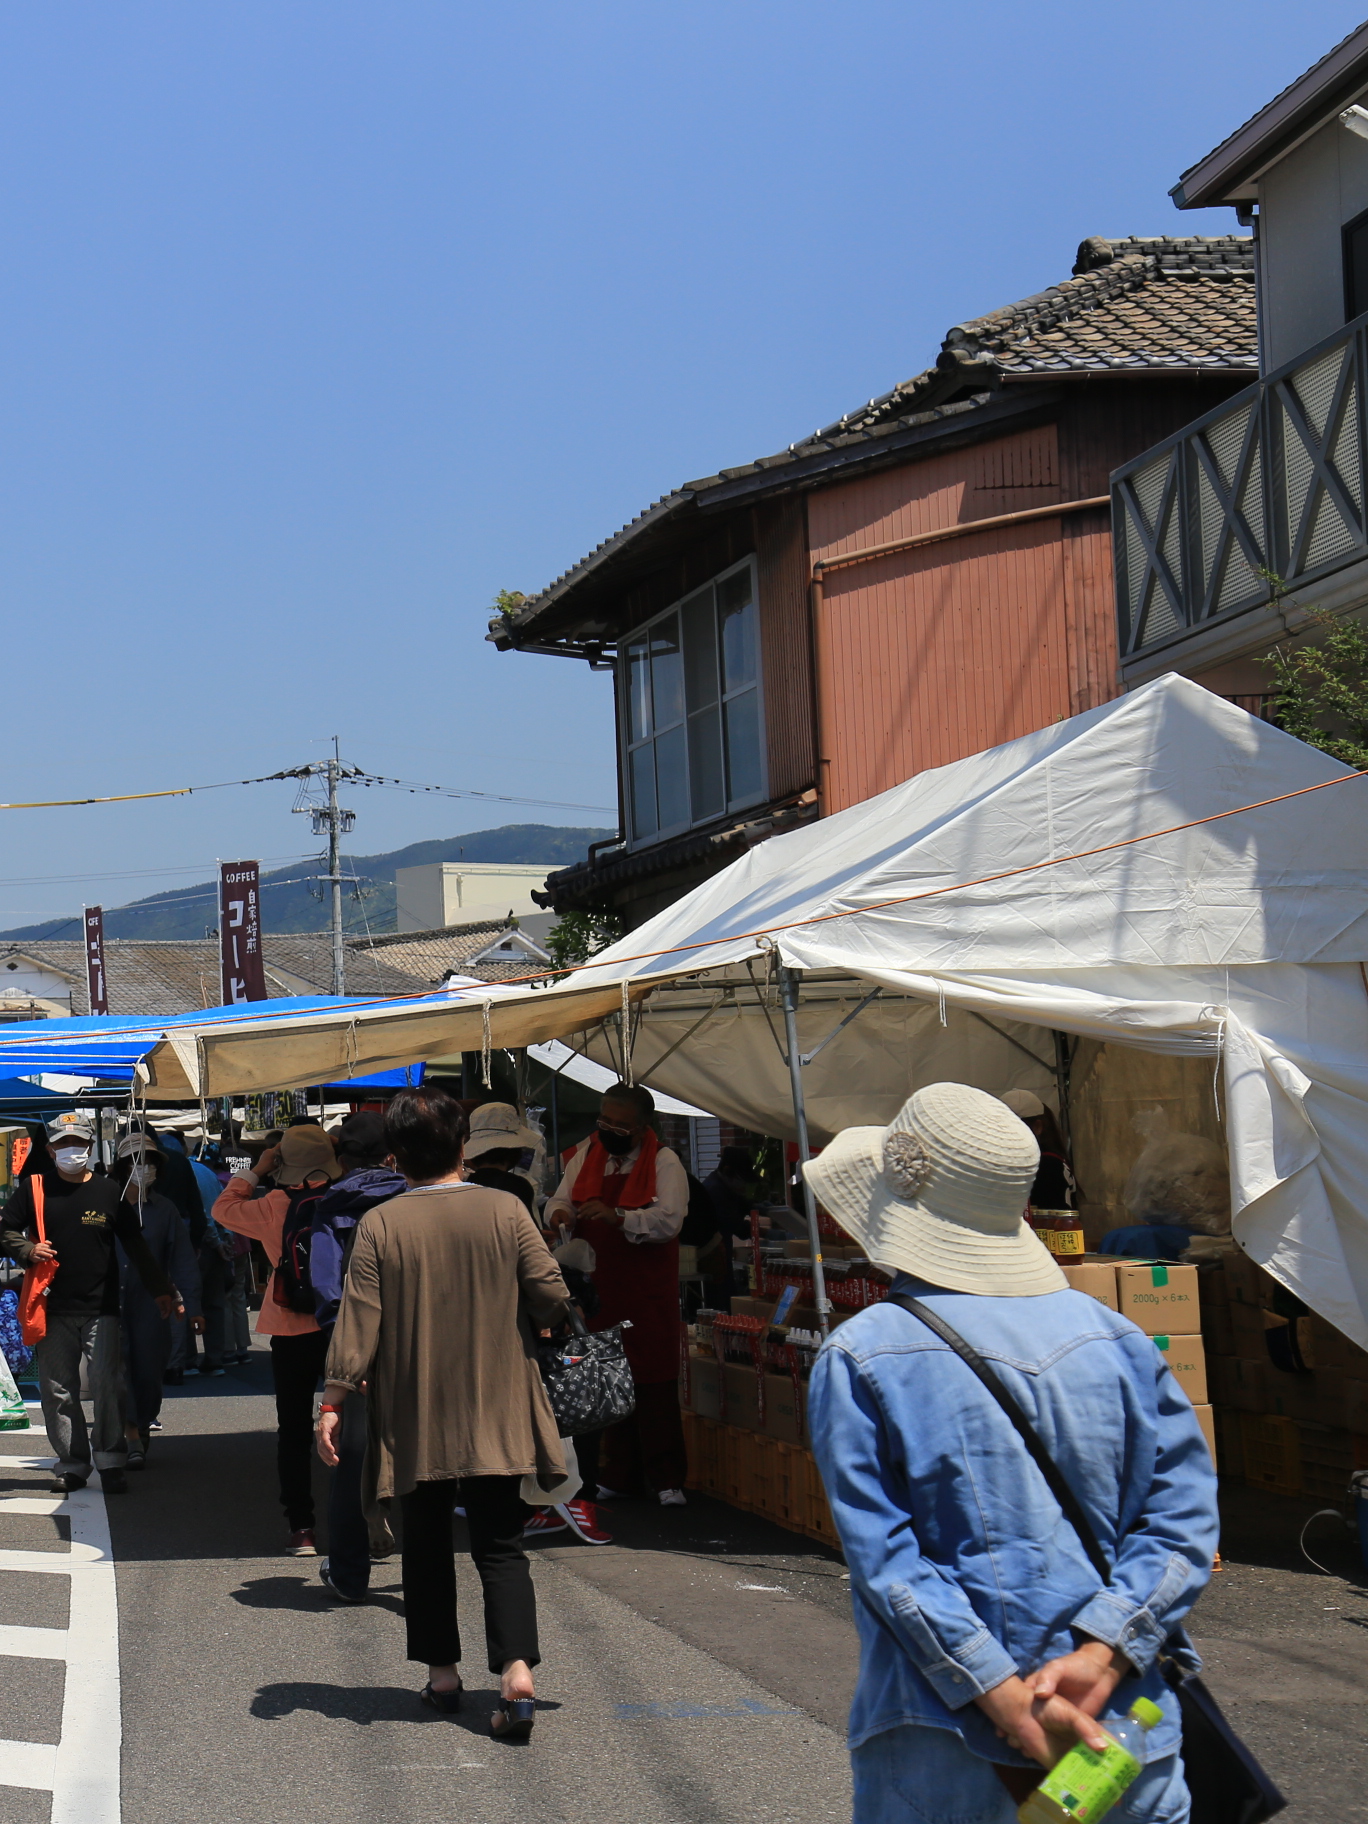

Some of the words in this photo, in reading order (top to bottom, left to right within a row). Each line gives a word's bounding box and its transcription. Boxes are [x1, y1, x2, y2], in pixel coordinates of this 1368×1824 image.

[226, 870, 256, 883] COFFEE
[246, 889, 257, 954] 自家焙煎
[1133, 1293, 1160, 1305] 2000g
[1171, 1293, 1190, 1303] 6本入
[1177, 1363, 1197, 1372] 6本入
